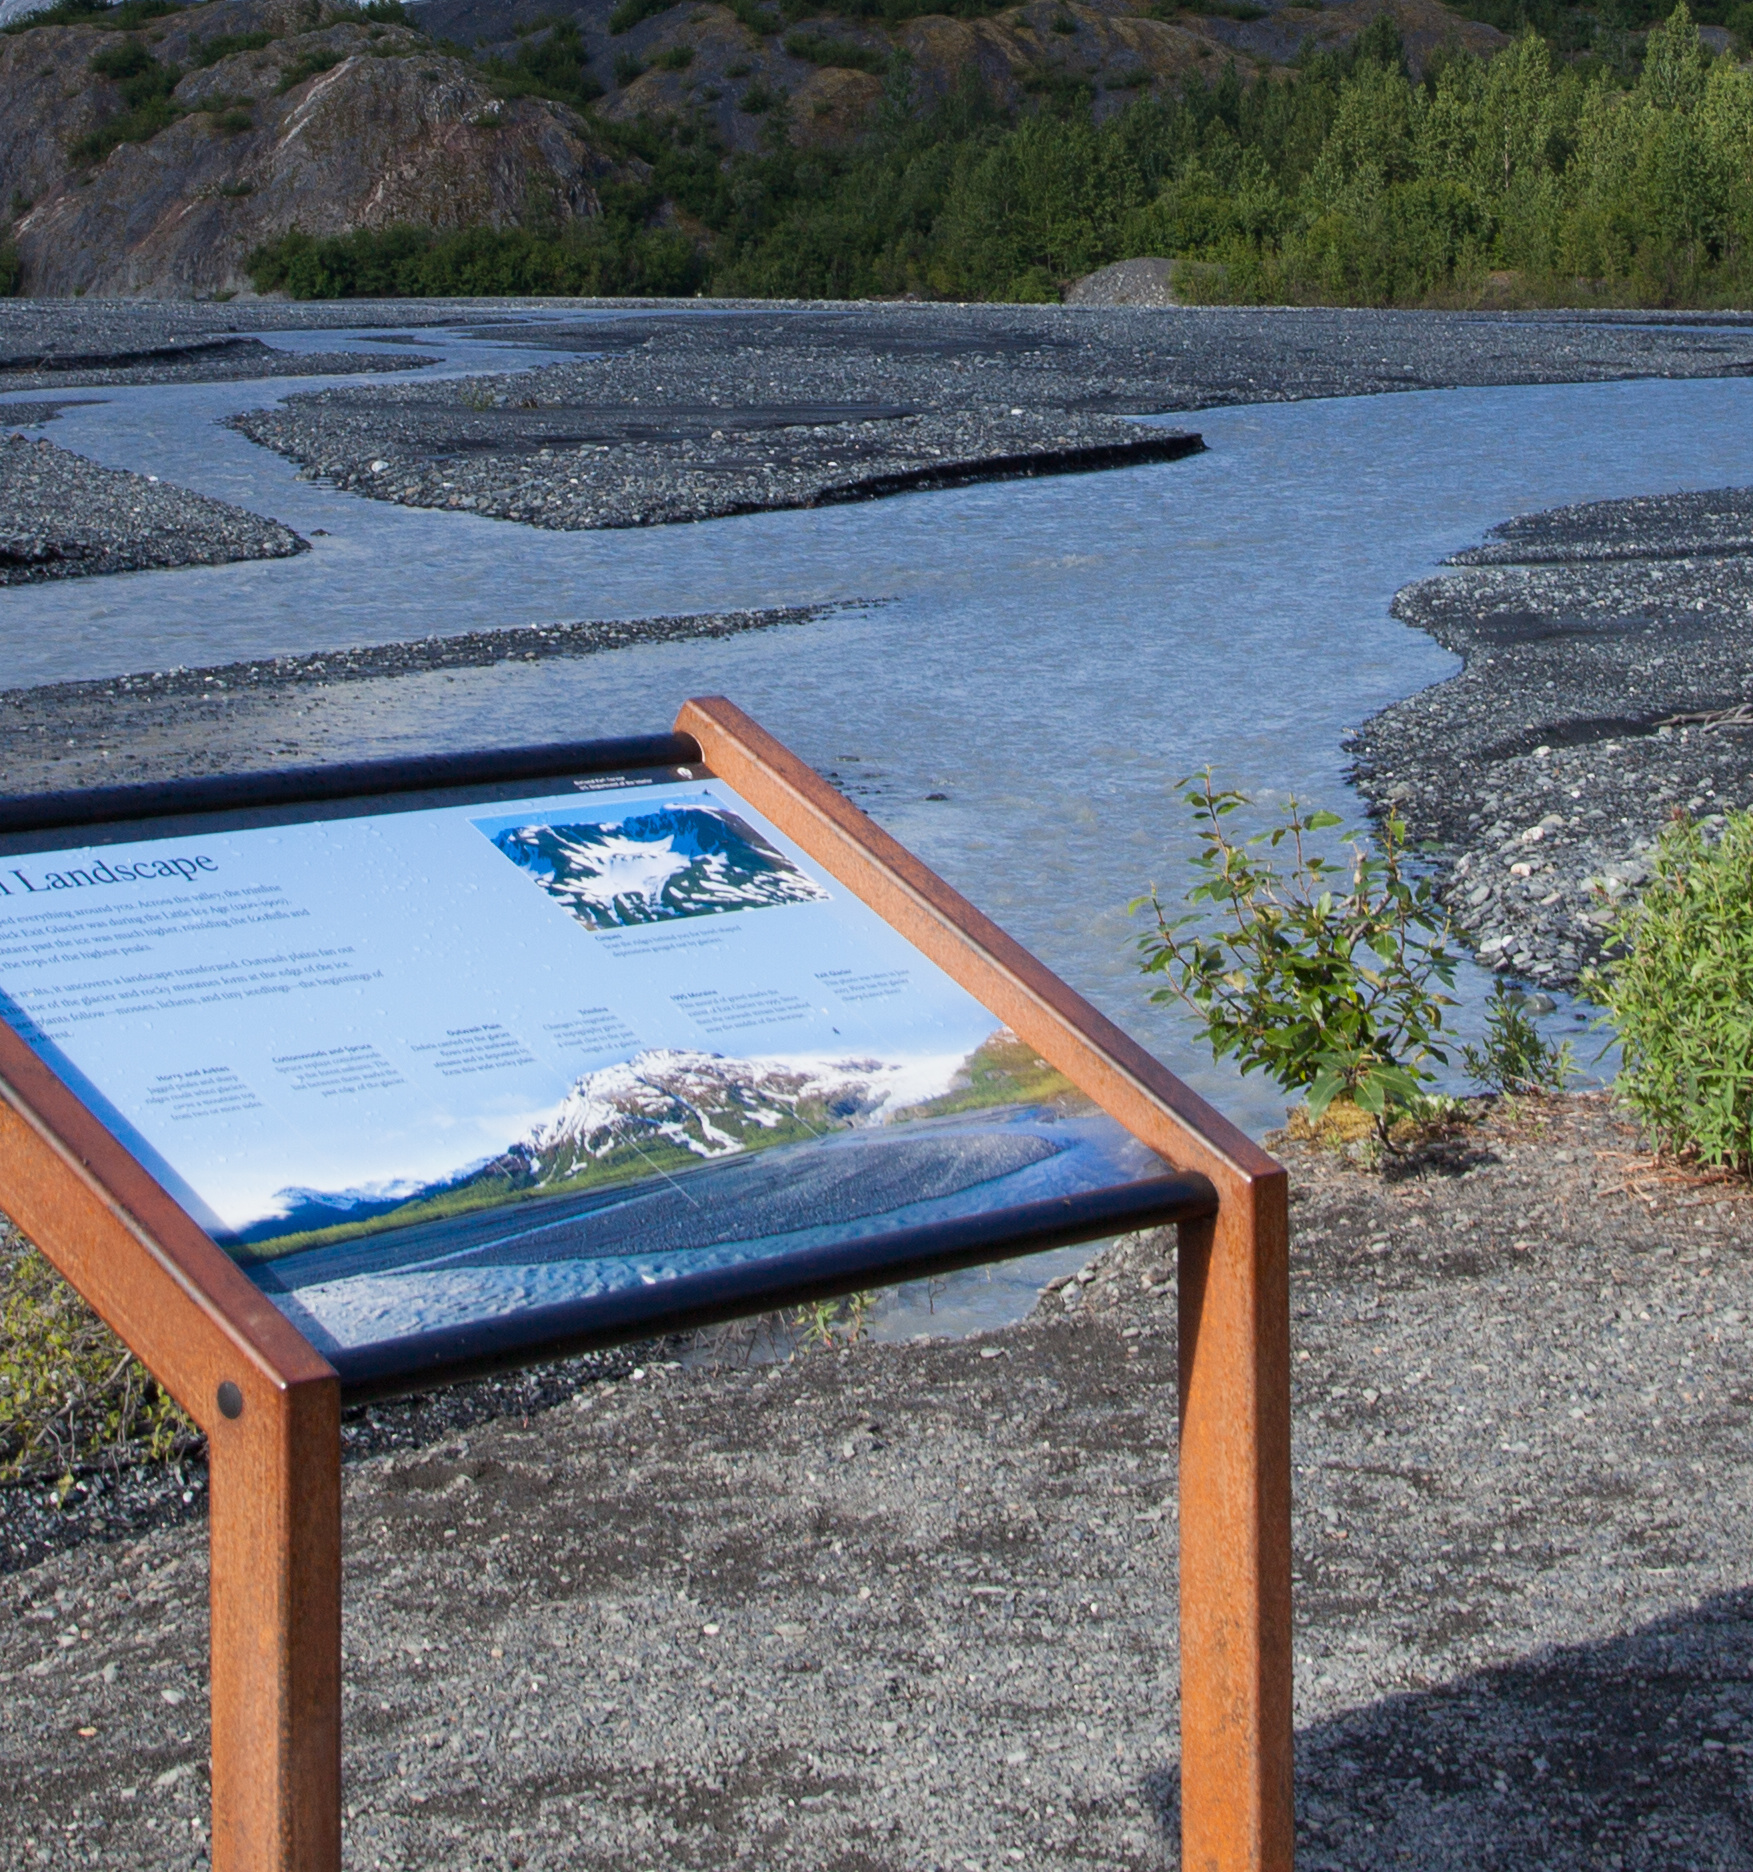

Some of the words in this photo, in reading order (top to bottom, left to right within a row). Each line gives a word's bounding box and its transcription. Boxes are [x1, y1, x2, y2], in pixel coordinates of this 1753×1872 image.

[11, 855, 218, 892] Landscape
[16, 911, 75, 922] everything
[74, 904, 111, 915] around
[137, 899, 172, 907] Across
[21, 928, 45, 936] Exit
[44, 925, 85, 933] Glacier
[107, 917, 145, 925] during
[162, 910, 191, 918] Little
[208, 906, 229, 915] Age
[30, 941, 53, 953] past
[53, 939, 74, 947] the
[114, 930, 144, 939] much
[182, 921, 231, 931] rounding
[291, 908, 310, 917] and
[21, 959, 46, 967] tops
[80, 947, 118, 959] highest
[64, 980, 112, 990] uncovers
[122, 972, 173, 982] landscape
[241, 954, 287, 966] Outwash
[288, 952, 318, 963] plains
[336, 945, 355, 953] out
[36, 1015, 68, 1028] plants
[201, 993, 221, 1002] and
[222, 992, 244, 1000] tiny
[316, 974, 372, 987] beginnings
[81, 995, 116, 1006] glacier
[118, 990, 140, 998] and
[141, 986, 172, 995] rocky
[173, 981, 220, 991] moraines
